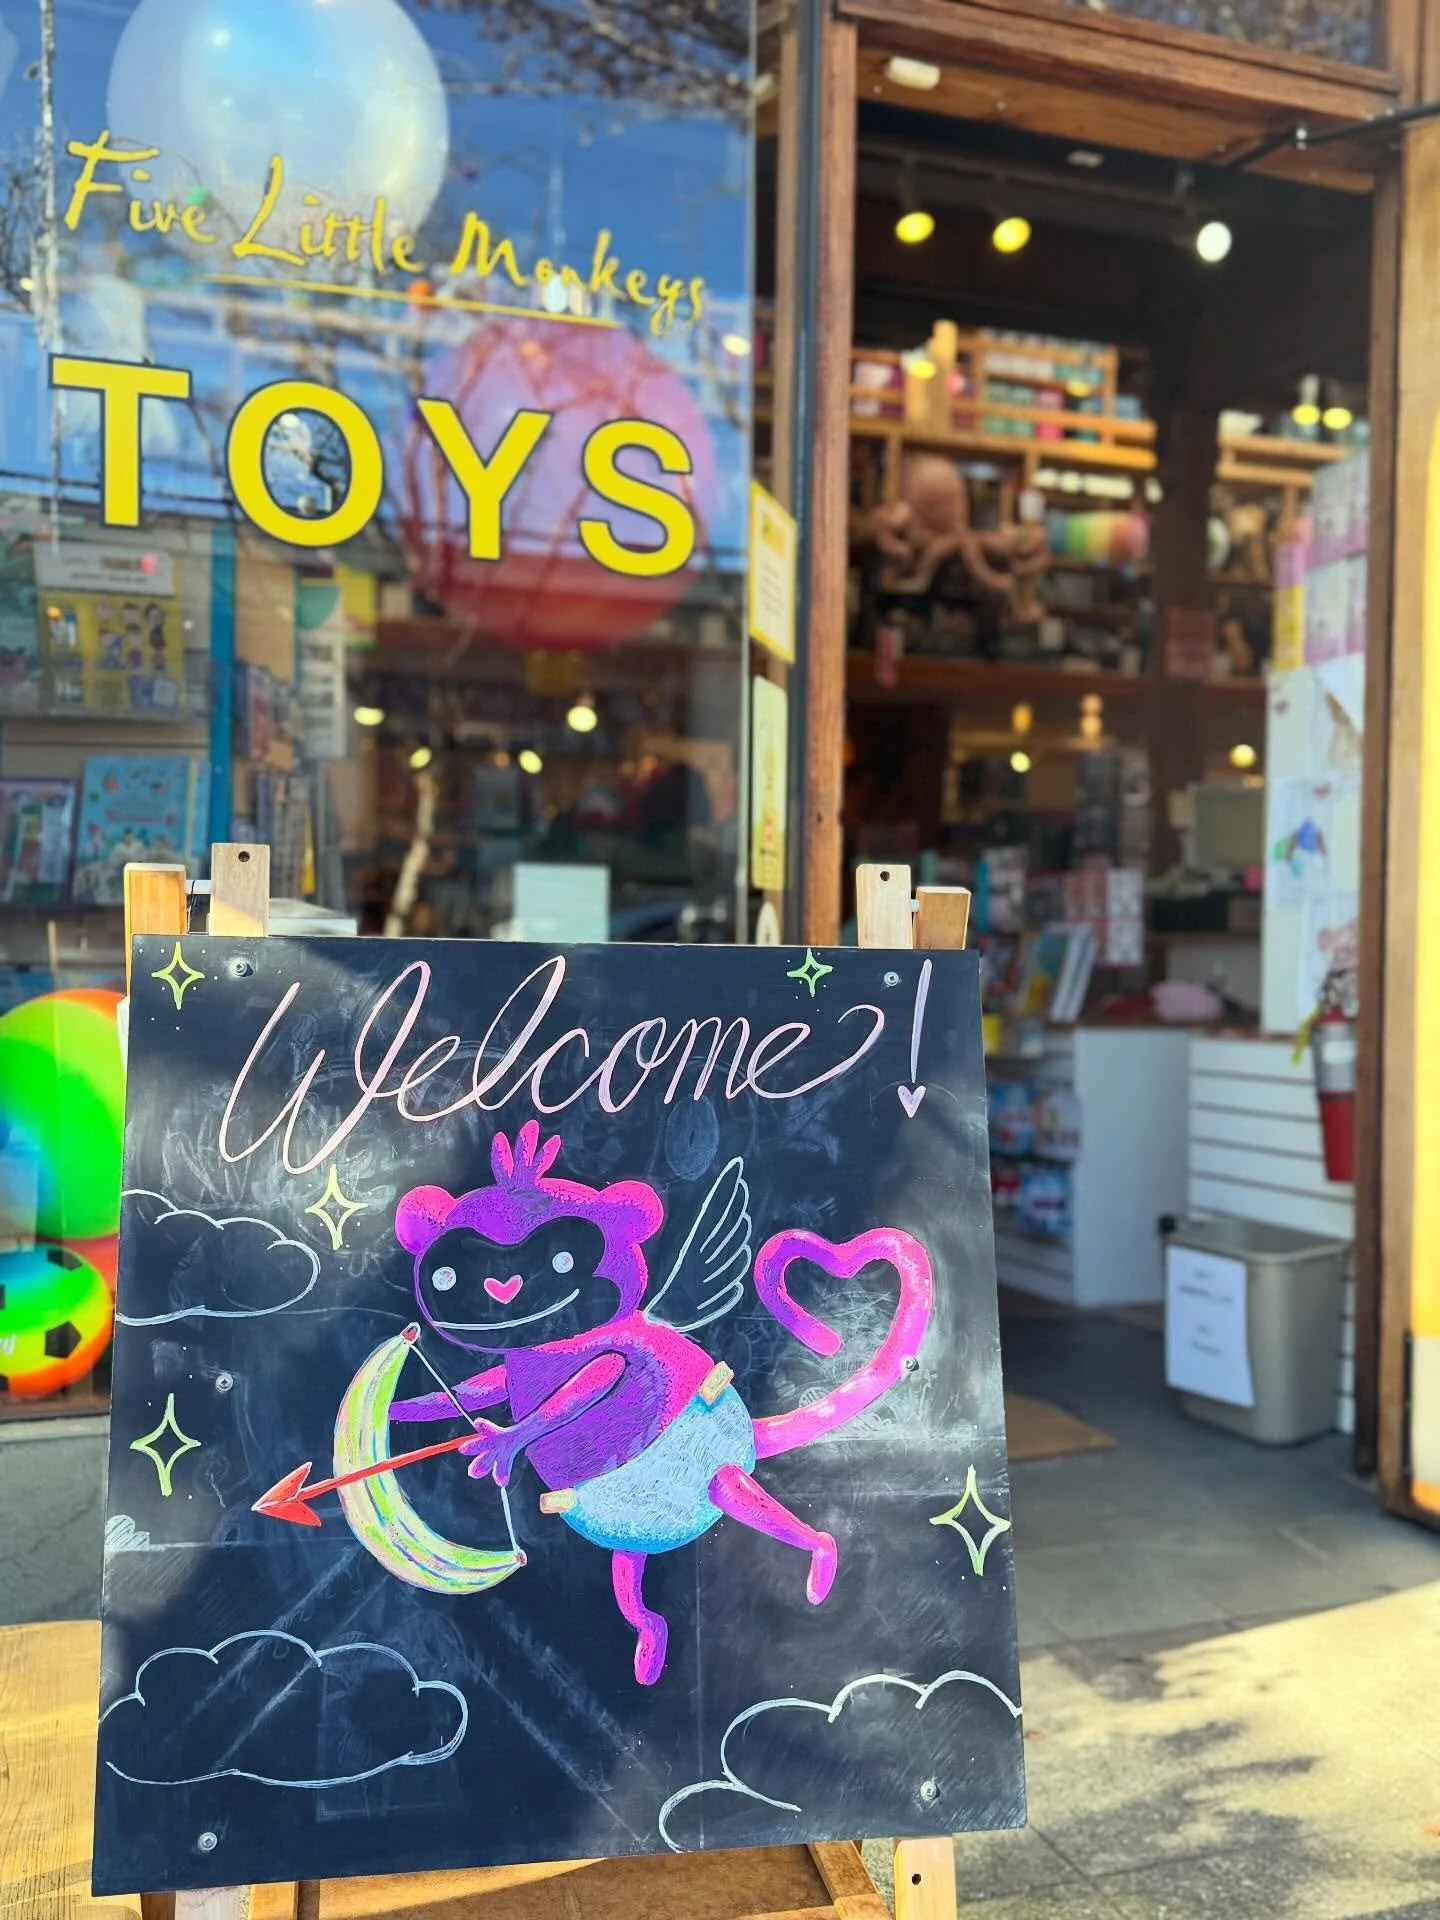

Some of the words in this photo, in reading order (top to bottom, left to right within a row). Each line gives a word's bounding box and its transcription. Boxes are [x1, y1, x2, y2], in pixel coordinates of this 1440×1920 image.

[65, 130, 217, 244] Five
[231, 153, 426, 274] Little
[451, 210, 705, 337] Monkeys
[49, 353, 696, 578] TOYS
